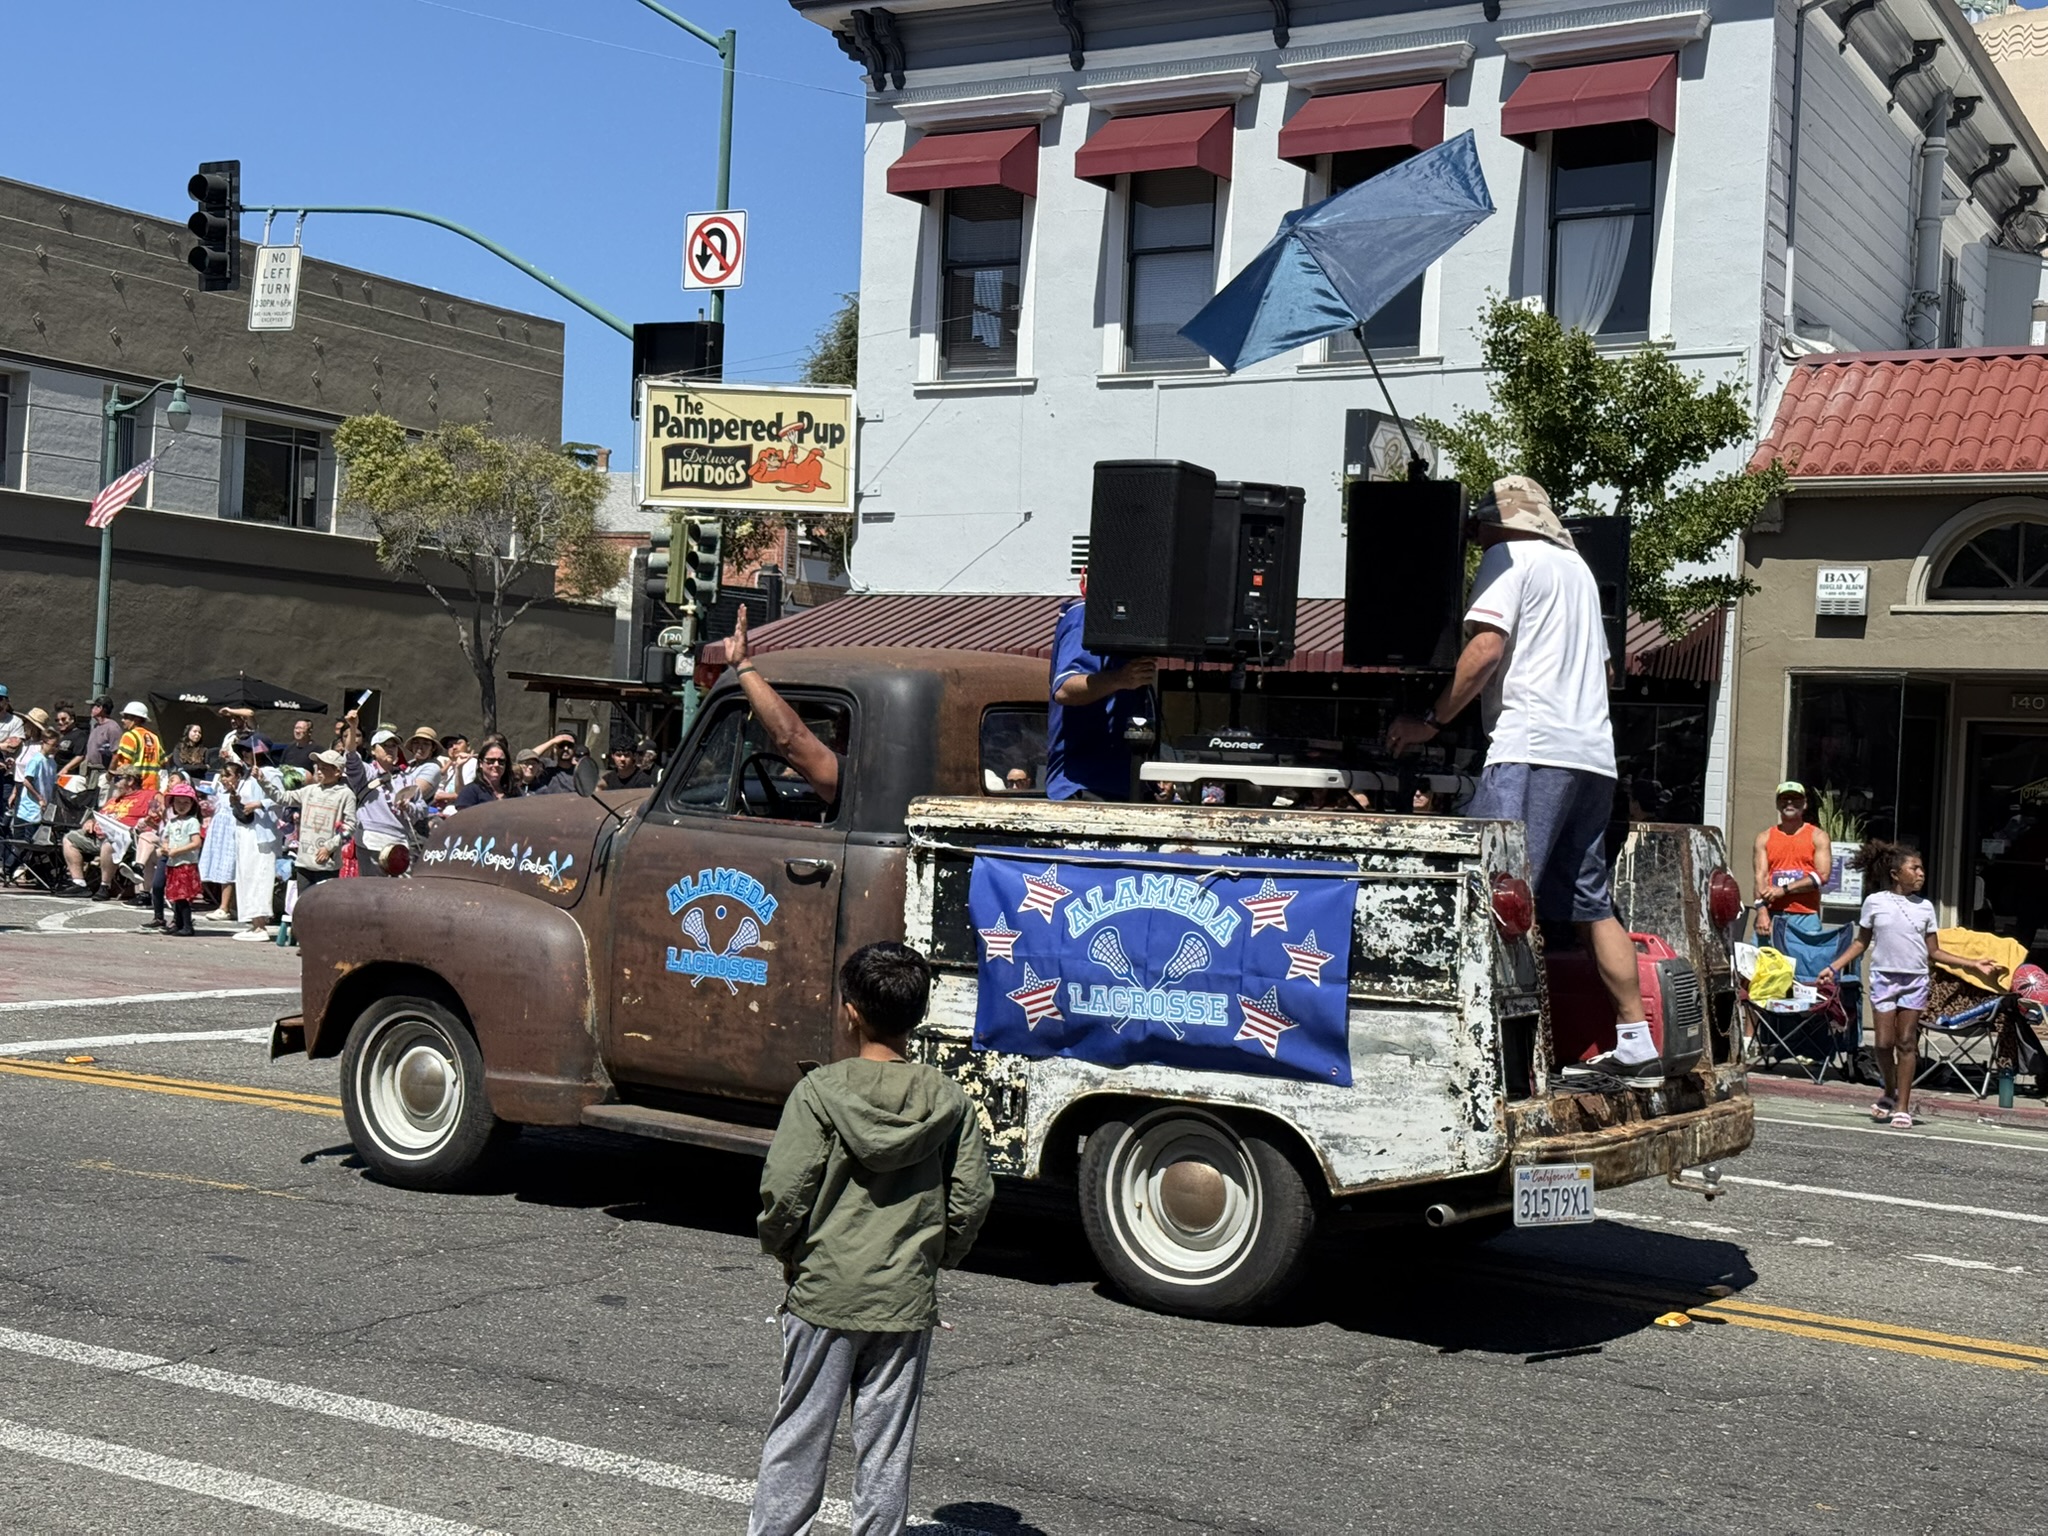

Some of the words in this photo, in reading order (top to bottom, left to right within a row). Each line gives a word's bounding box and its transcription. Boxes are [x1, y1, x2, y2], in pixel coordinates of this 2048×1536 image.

[272, 253, 286, 263] NO
[263, 268, 291, 279] LEFT
[261, 284, 291, 294] TURN
[674, 394, 704, 415] The
[652, 404, 784, 443] Pampered
[797, 411, 845, 449] Pup
[683, 448, 735, 464] Deluxe
[668, 458, 703, 483] HOT
[703, 459, 748, 485] DOGS
[1825, 573, 1860, 583] BAY
[663, 633, 682, 643] TRO
[1208, 737, 1264, 750] Pioneer
[665, 867, 779, 925] ALAMEDA
[1063, 874, 1242, 948] ALAMEDA
[666, 947, 768, 986] LACROSSE
[1068, 982, 1229, 1027] LACROSSE
[1531, 1168, 1580, 1186] California
[1521, 1186, 1590, 1218] 31579X1
